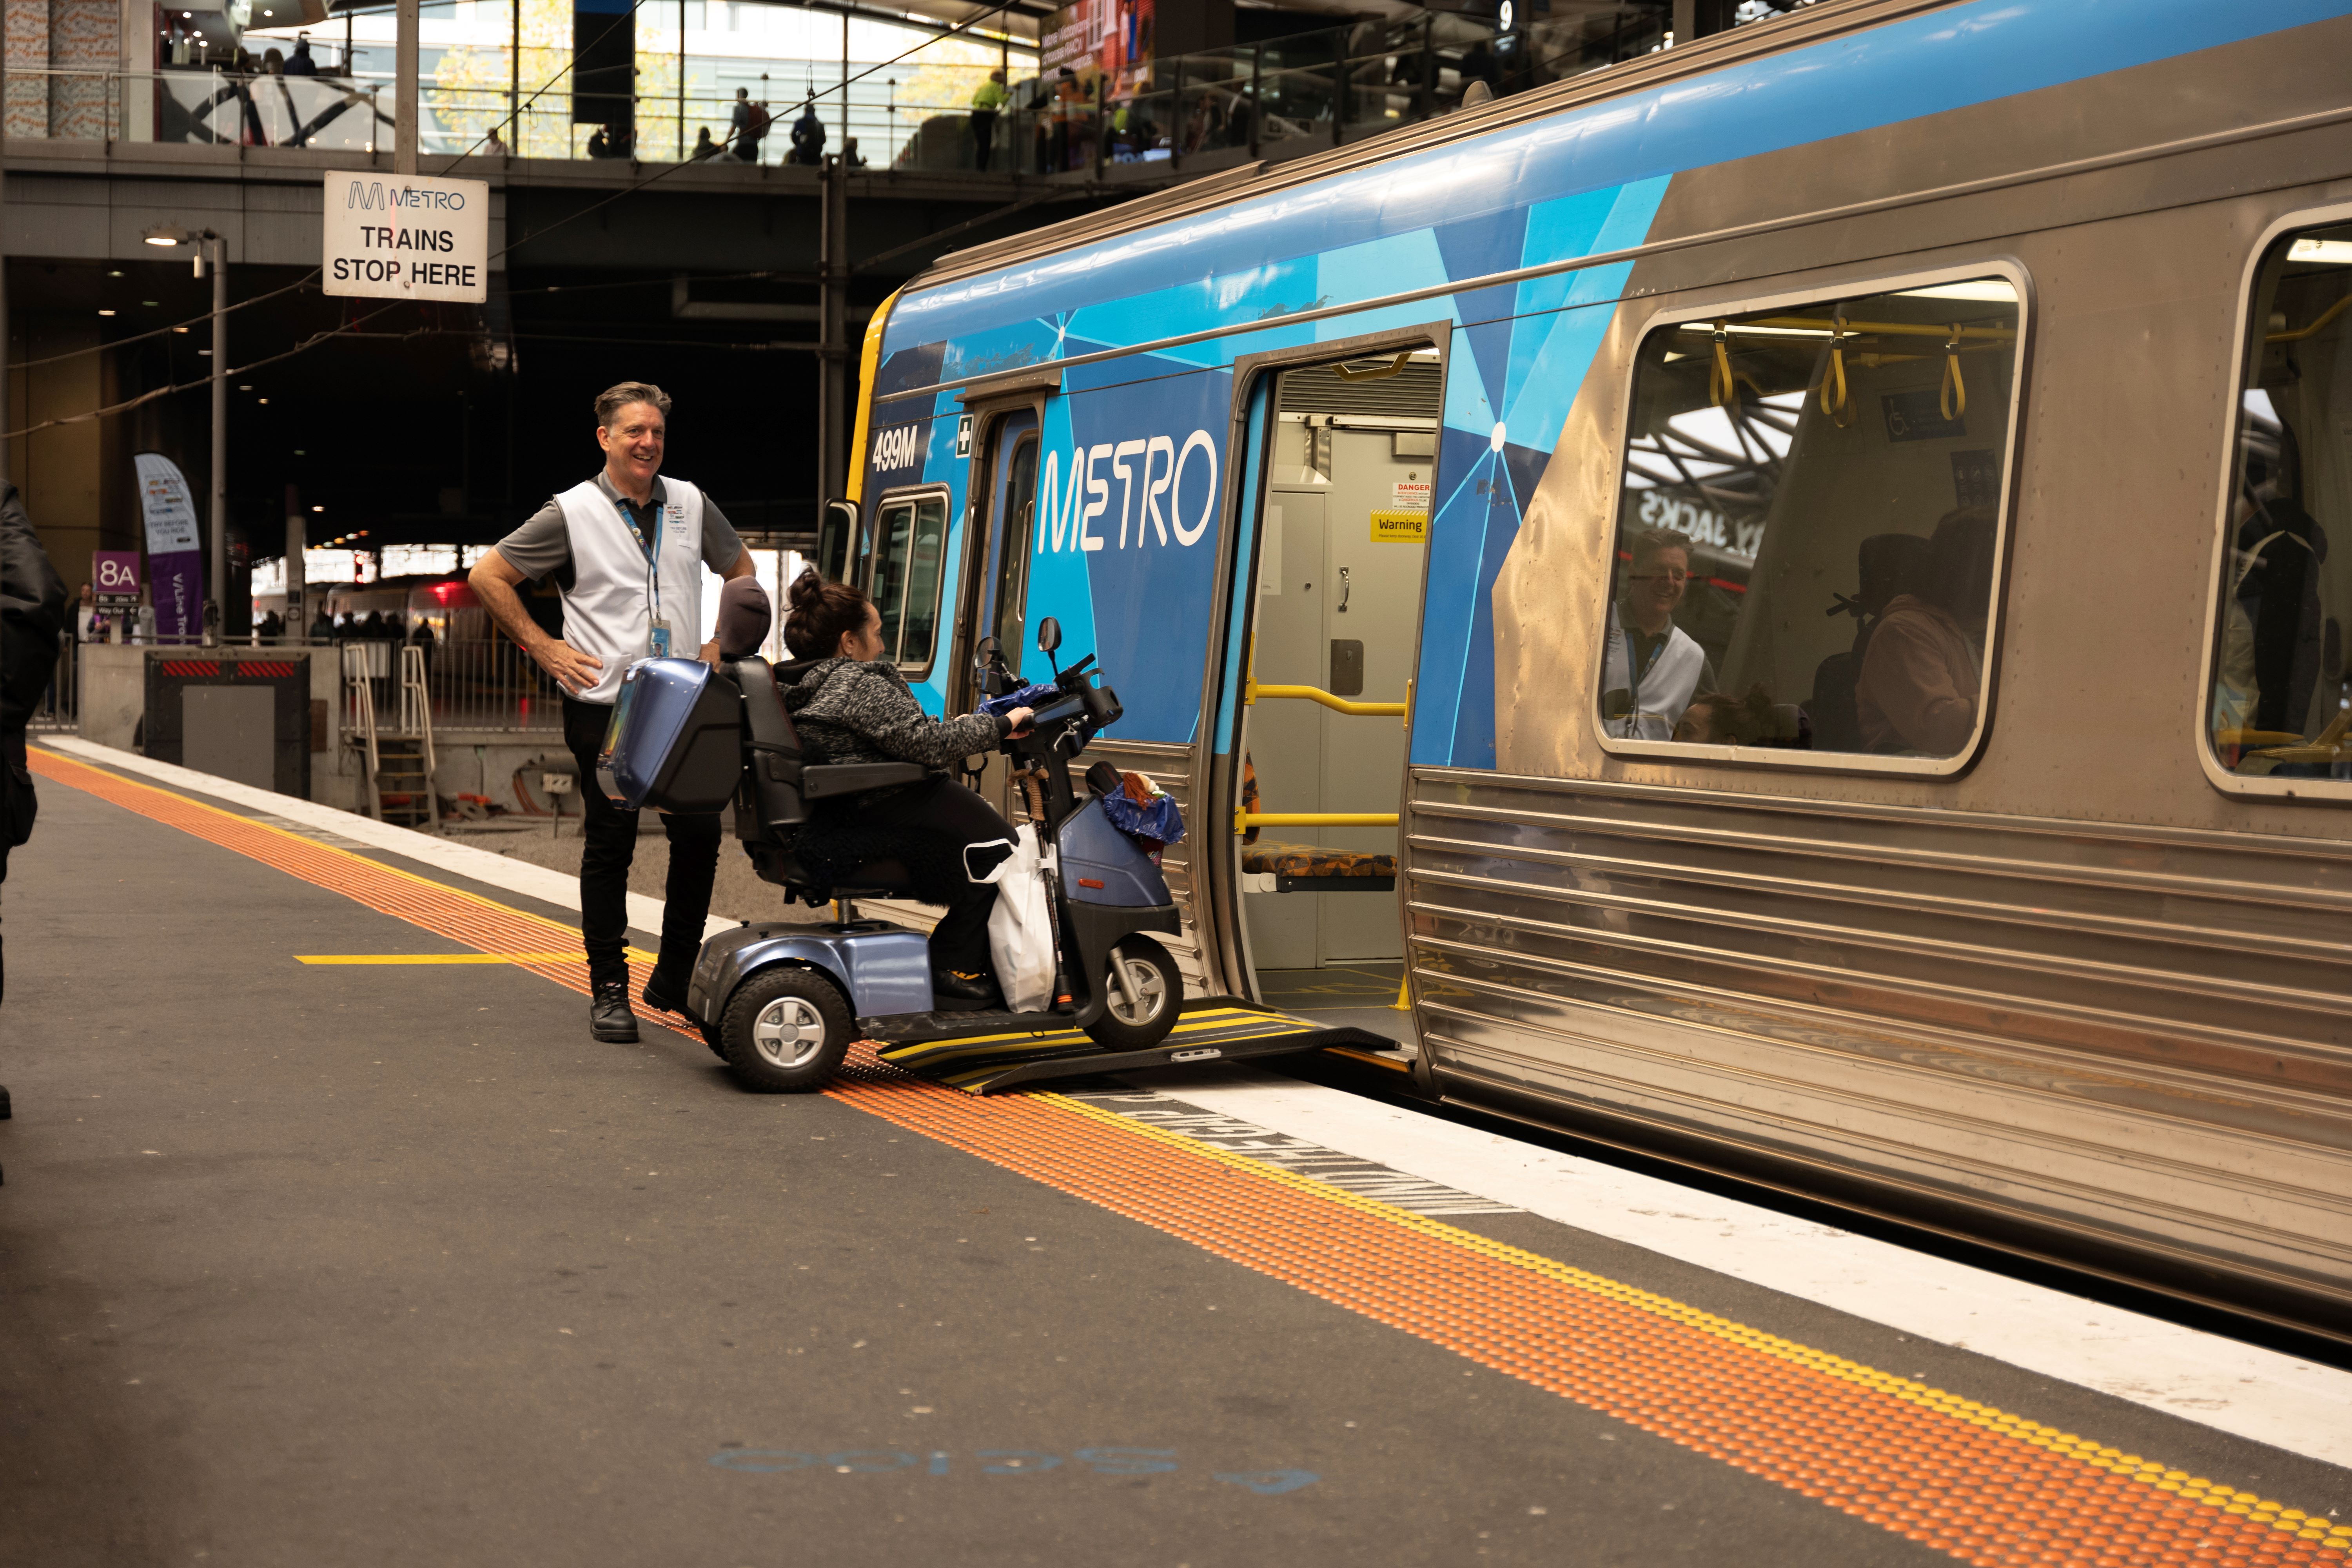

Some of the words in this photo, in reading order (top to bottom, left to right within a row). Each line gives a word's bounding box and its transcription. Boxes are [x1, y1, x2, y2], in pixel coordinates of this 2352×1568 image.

[1500, 0, 1512, 31] 9
[390, 189, 465, 211] METRO
[360, 226, 454, 252] TRAINS
[333, 258, 401, 282] STOP
[412, 262, 476, 287] HERE
[872, 425, 918, 472] 499M
[1038, 429, 1217, 555] METRO
[1379, 519, 1422, 533] Warning
[100, 560, 136, 587] 8A
[172, 572, 185, 615] V/Line
[98, 606, 111, 615] Way
